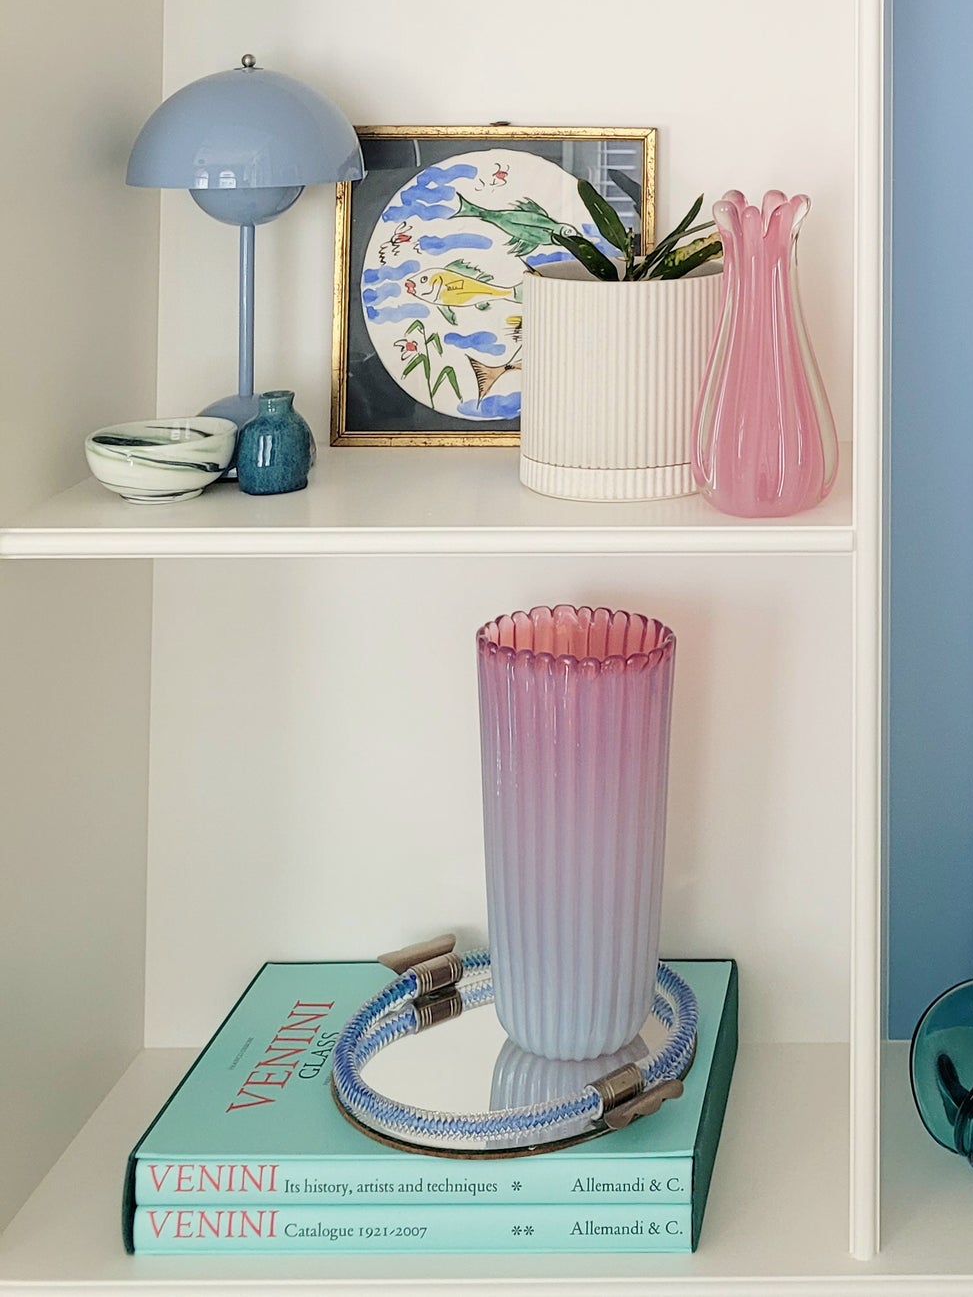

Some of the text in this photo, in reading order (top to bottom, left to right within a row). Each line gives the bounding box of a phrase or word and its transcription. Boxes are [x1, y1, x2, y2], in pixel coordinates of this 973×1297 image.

[225, 1000, 335, 1113] VENINI
[298, 1031, 340, 1079] GLASS
[147, 1164, 498, 1197] VENINI Its history, artists and techniques
[571, 1177, 685, 1192] Allemandi & C.
[146, 1210, 280, 1238] VENINI
[284, 1223, 354, 1241] Catalogue
[569, 1220, 684, 1236] Allemandi & C.
